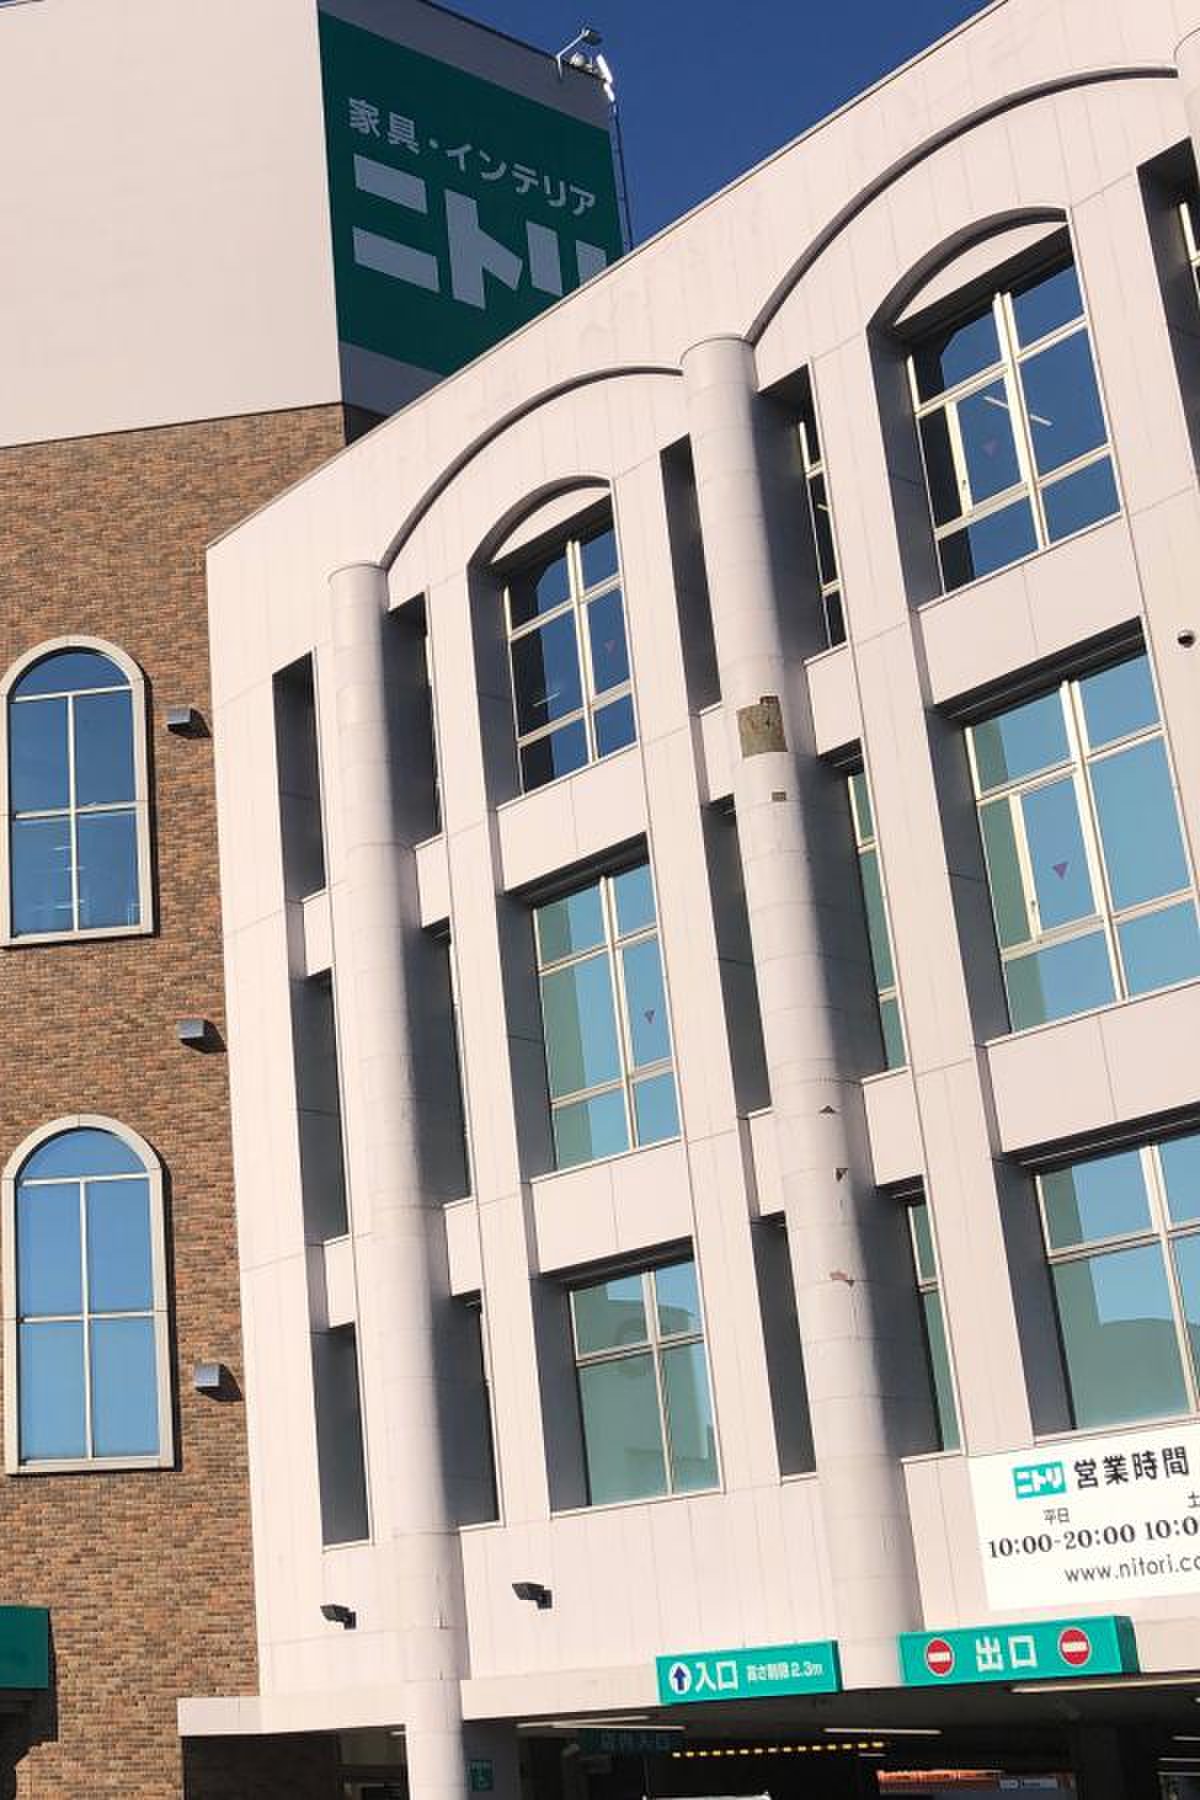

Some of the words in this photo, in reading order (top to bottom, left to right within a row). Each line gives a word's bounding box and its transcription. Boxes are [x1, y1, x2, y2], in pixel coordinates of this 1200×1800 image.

[348, 97, 596, 216] 家具・インテリア
[1016, 1465, 1065, 1494] ニトリ
[1073, 1446, 1190, 1490] 営業時間
[1043, 1507, 1070, 1524] 平日
[988, 1523, 1136, 1558] 10:00-20:00
[974, 1634, 1039, 1672] 出口
[694, 1660, 738, 1692] 入口
